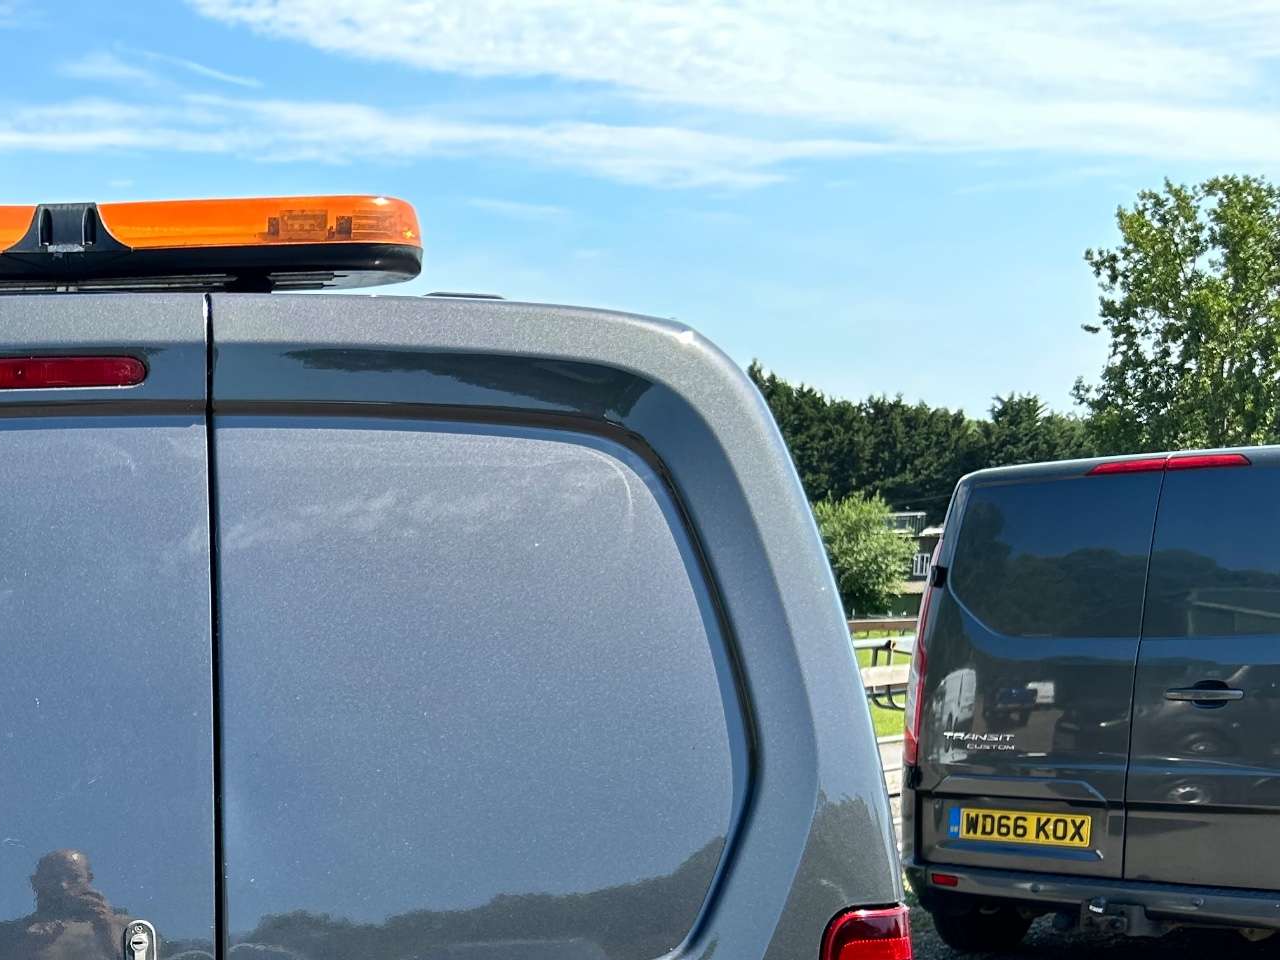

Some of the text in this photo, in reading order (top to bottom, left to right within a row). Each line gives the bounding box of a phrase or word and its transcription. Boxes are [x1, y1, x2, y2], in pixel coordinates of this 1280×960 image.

[943, 731, 1015, 742] TRANSIT
[966, 743, 1015, 751] CUSTOM
[964, 812, 1086, 842] WD66 KOX
